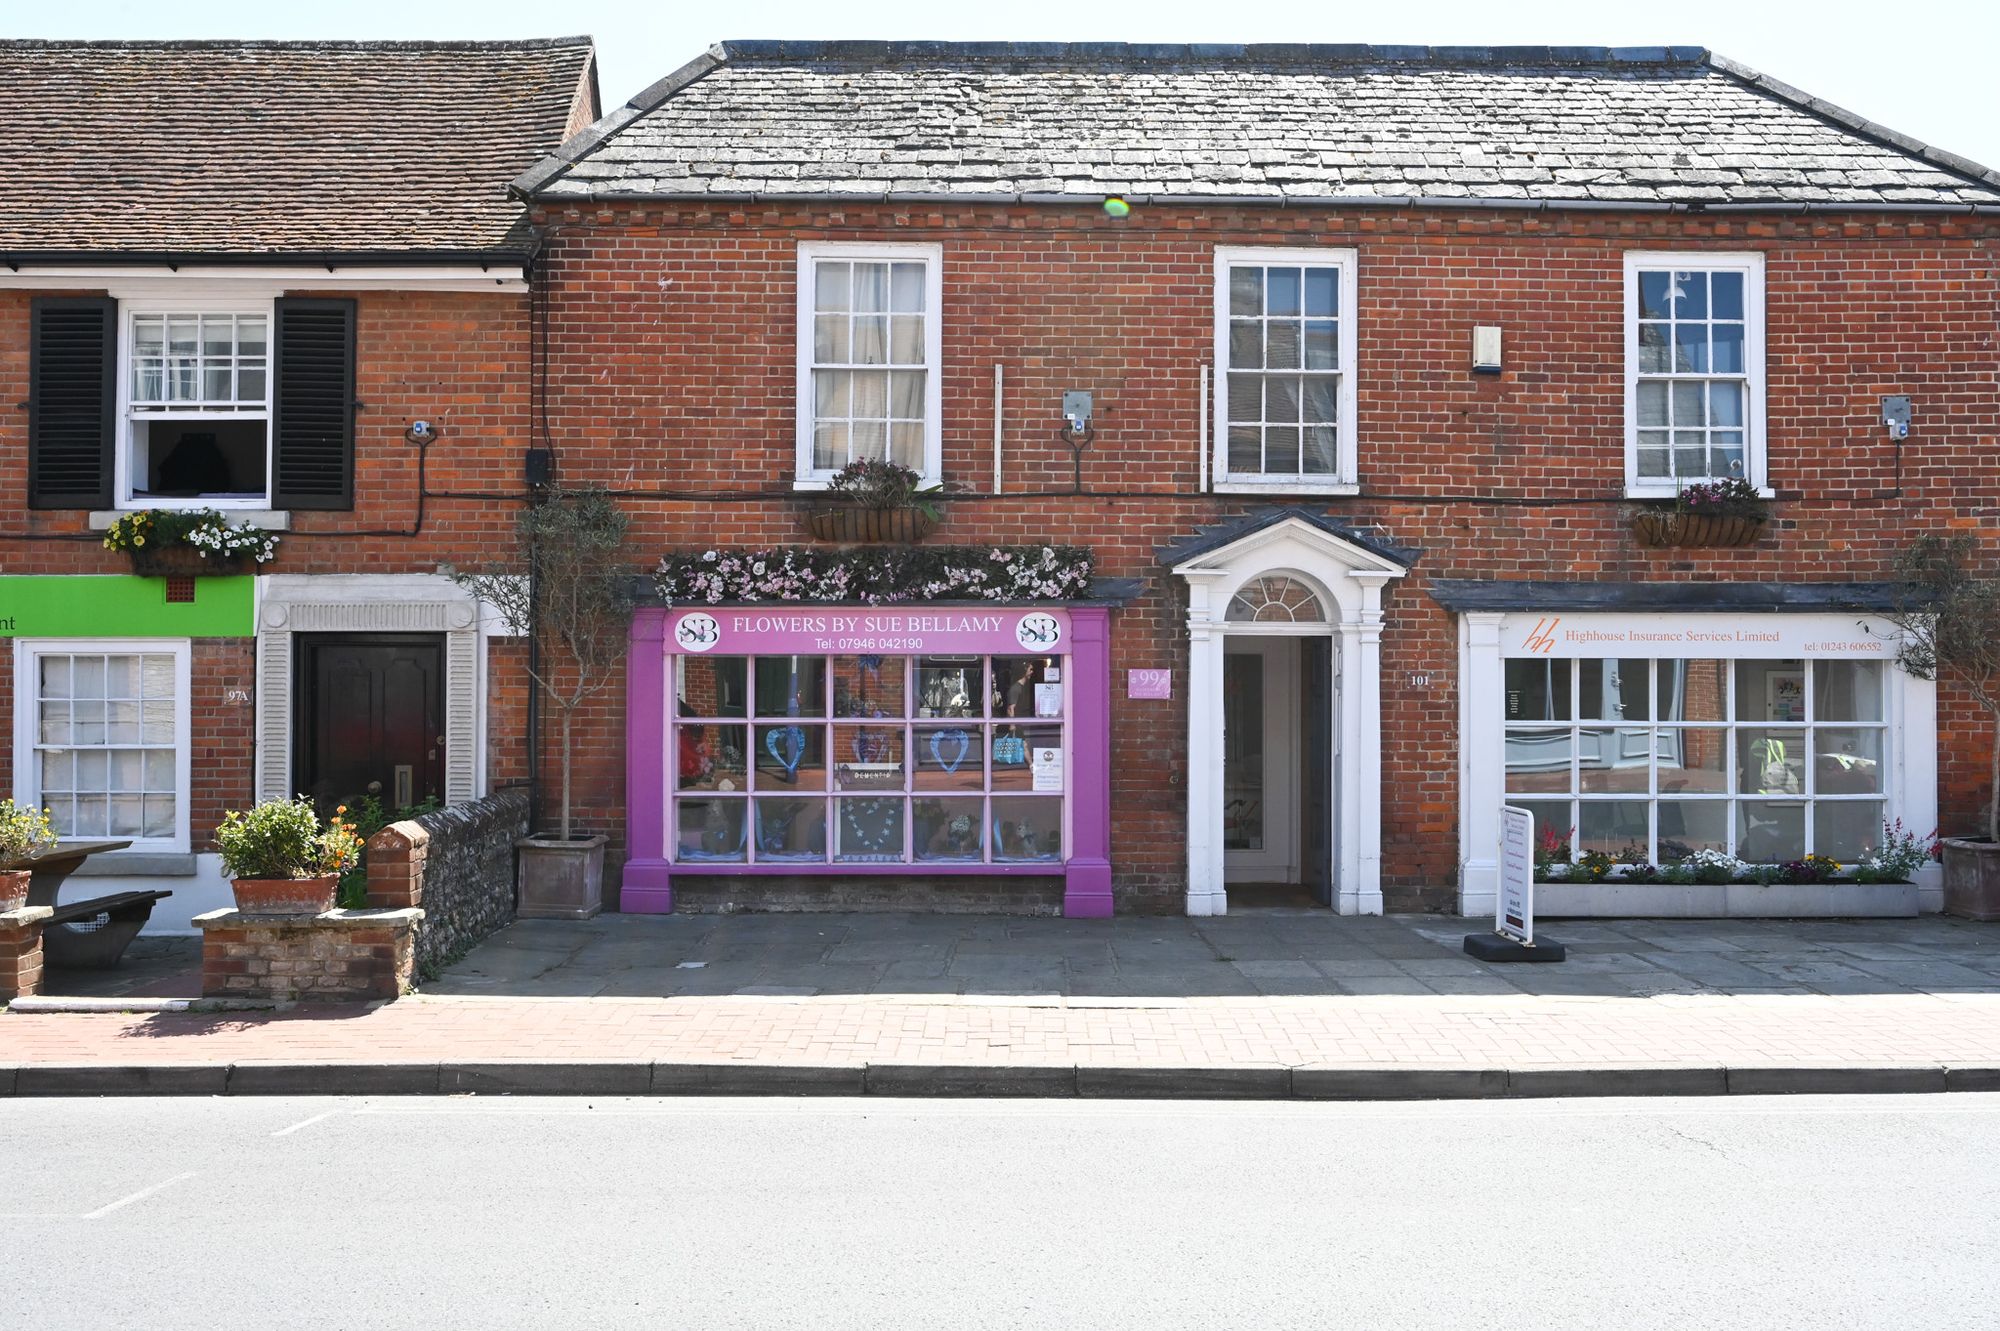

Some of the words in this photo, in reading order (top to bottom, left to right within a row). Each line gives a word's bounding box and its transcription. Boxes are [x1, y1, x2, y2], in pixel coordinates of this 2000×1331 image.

[733, 617, 826, 633] FLOWERS
[832, 617, 857, 632] BY
[864, 617, 901, 632] SUE
[907, 617, 1003, 632] BELLAMY
[1565, 629, 1625, 643] Highhouse
[1628, 630, 1682, 641] Insurance
[1686, 629, 1732, 641] Services
[1736, 630, 1780, 642] Limited
[815, 638, 836, 649] Tel:
[838, 638, 876, 649] 07946
[879, 638, 923, 649] 042190
[1804, 641, 1819, 651] tel:
[1821, 641, 1847, 651] 01243
[1849, 641, 1882, 651] 606552
[1139, 670, 1159, 687] 99
[1412, 675, 1430, 686] 101
[228, 690, 248, 701] 97A
